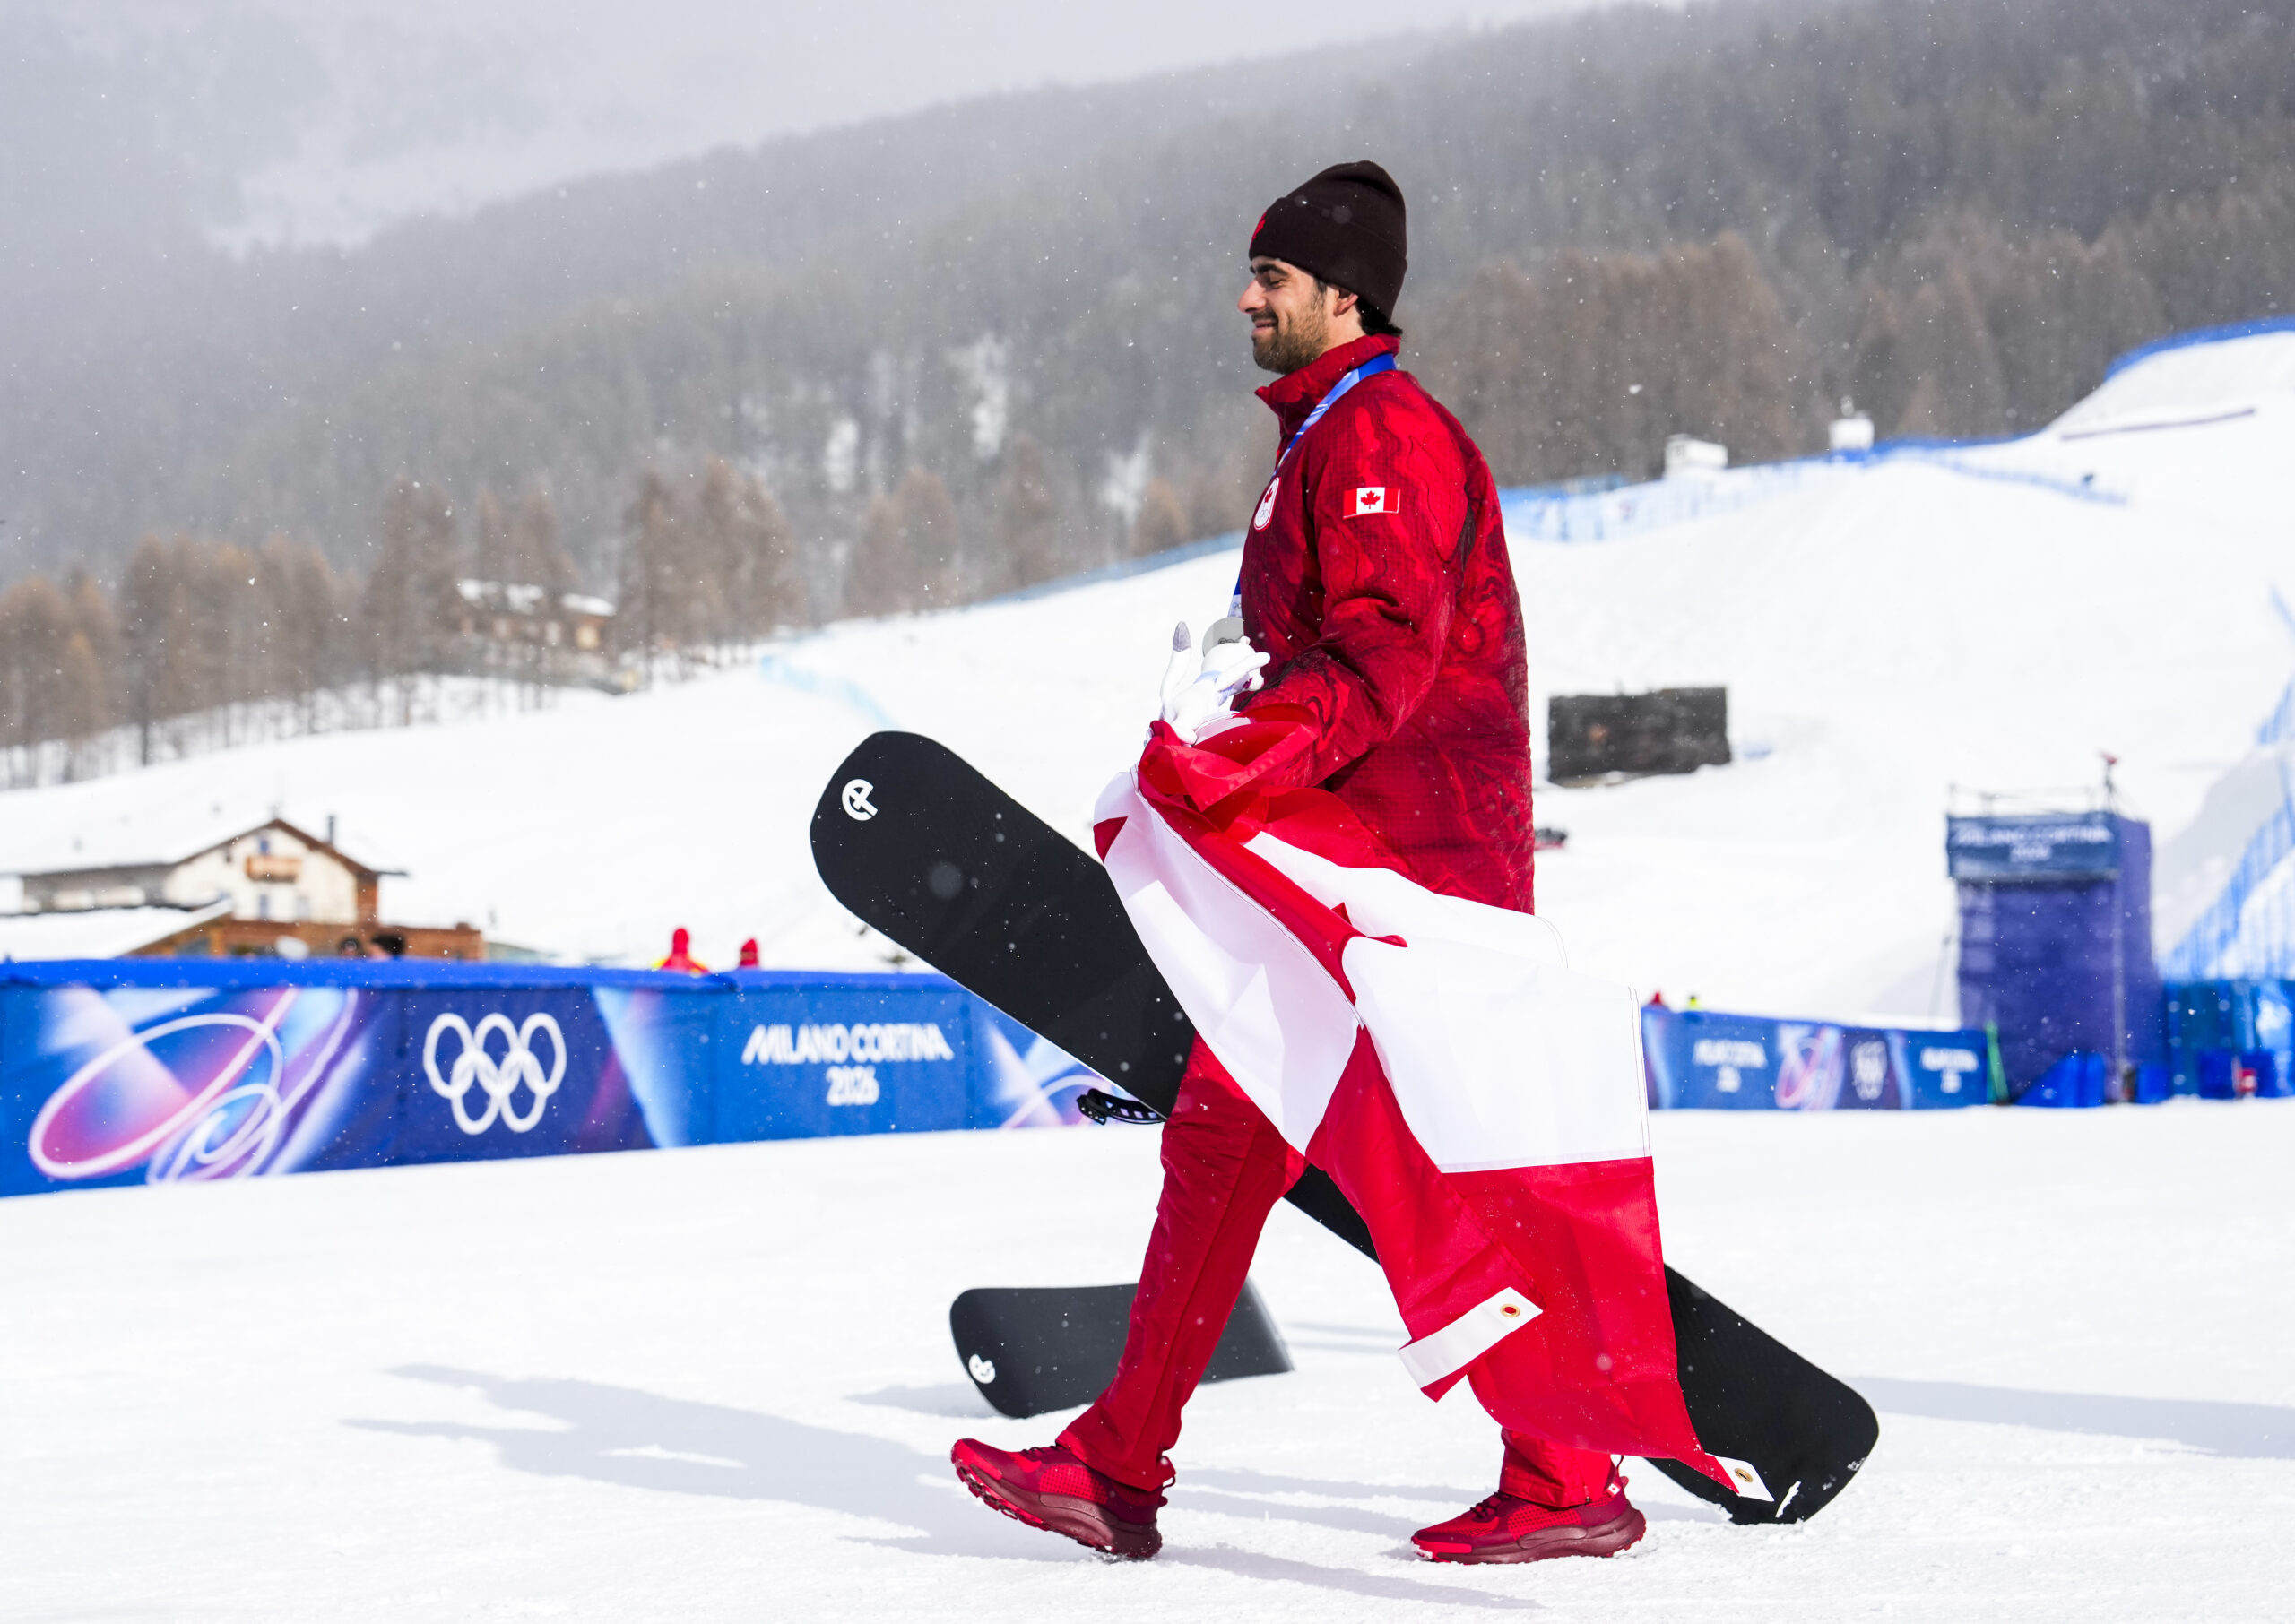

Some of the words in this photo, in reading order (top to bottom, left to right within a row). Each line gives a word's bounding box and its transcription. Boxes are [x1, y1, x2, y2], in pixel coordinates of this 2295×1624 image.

[741, 1024, 848, 1064] MILANO
[848, 1023, 954, 1062] CORTINA
[825, 1065, 879, 1106] 2026
